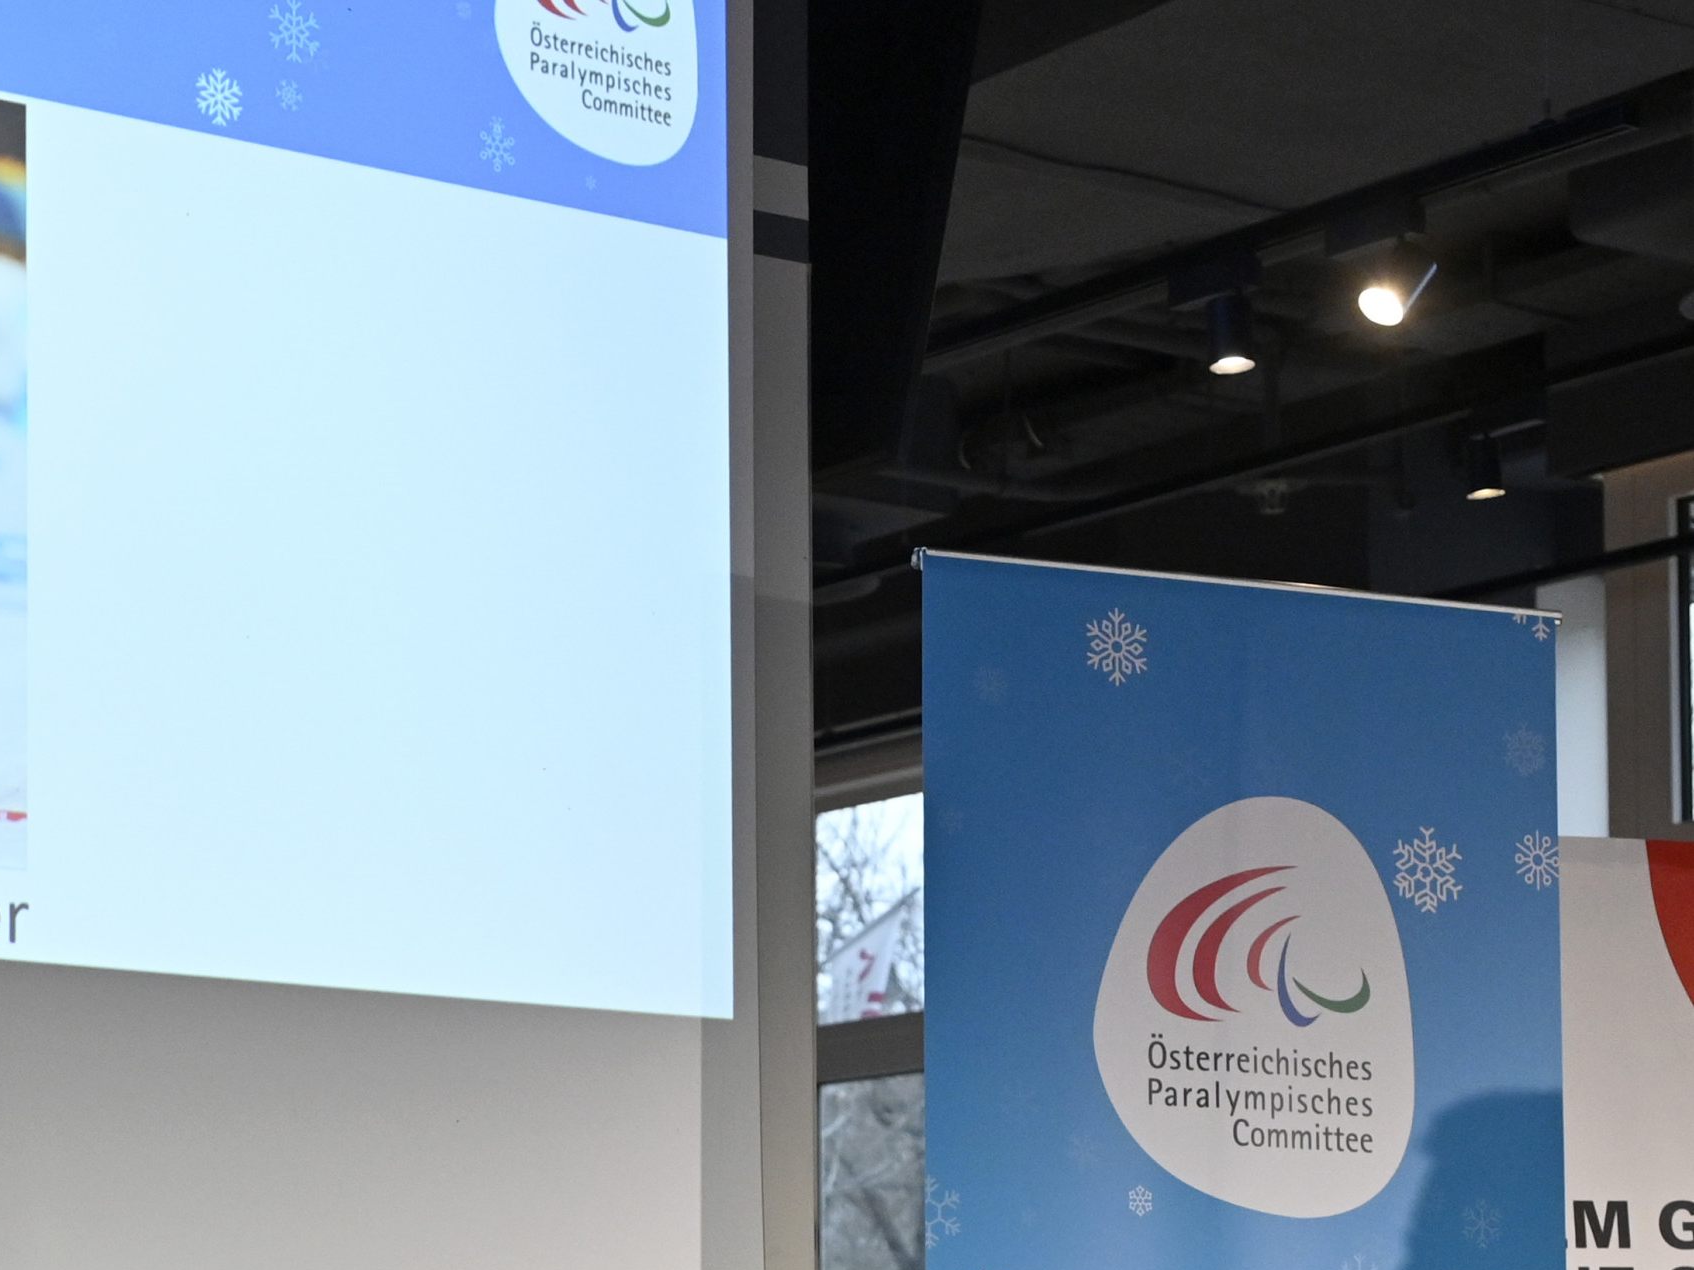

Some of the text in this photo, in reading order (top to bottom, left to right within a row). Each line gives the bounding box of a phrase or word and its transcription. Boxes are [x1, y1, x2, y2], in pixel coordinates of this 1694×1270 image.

[529, 20, 673, 77] Österreichisches
[529, 52, 673, 102] Paralympisches
[581, 88, 672, 127] Committee
[1147, 1033, 1373, 1082] Österreichisches
[1147, 1078, 1374, 1120] Paralympisches
[1231, 1119, 1374, 1153] Committee
[1565, 1200, 1632, 1249] M
